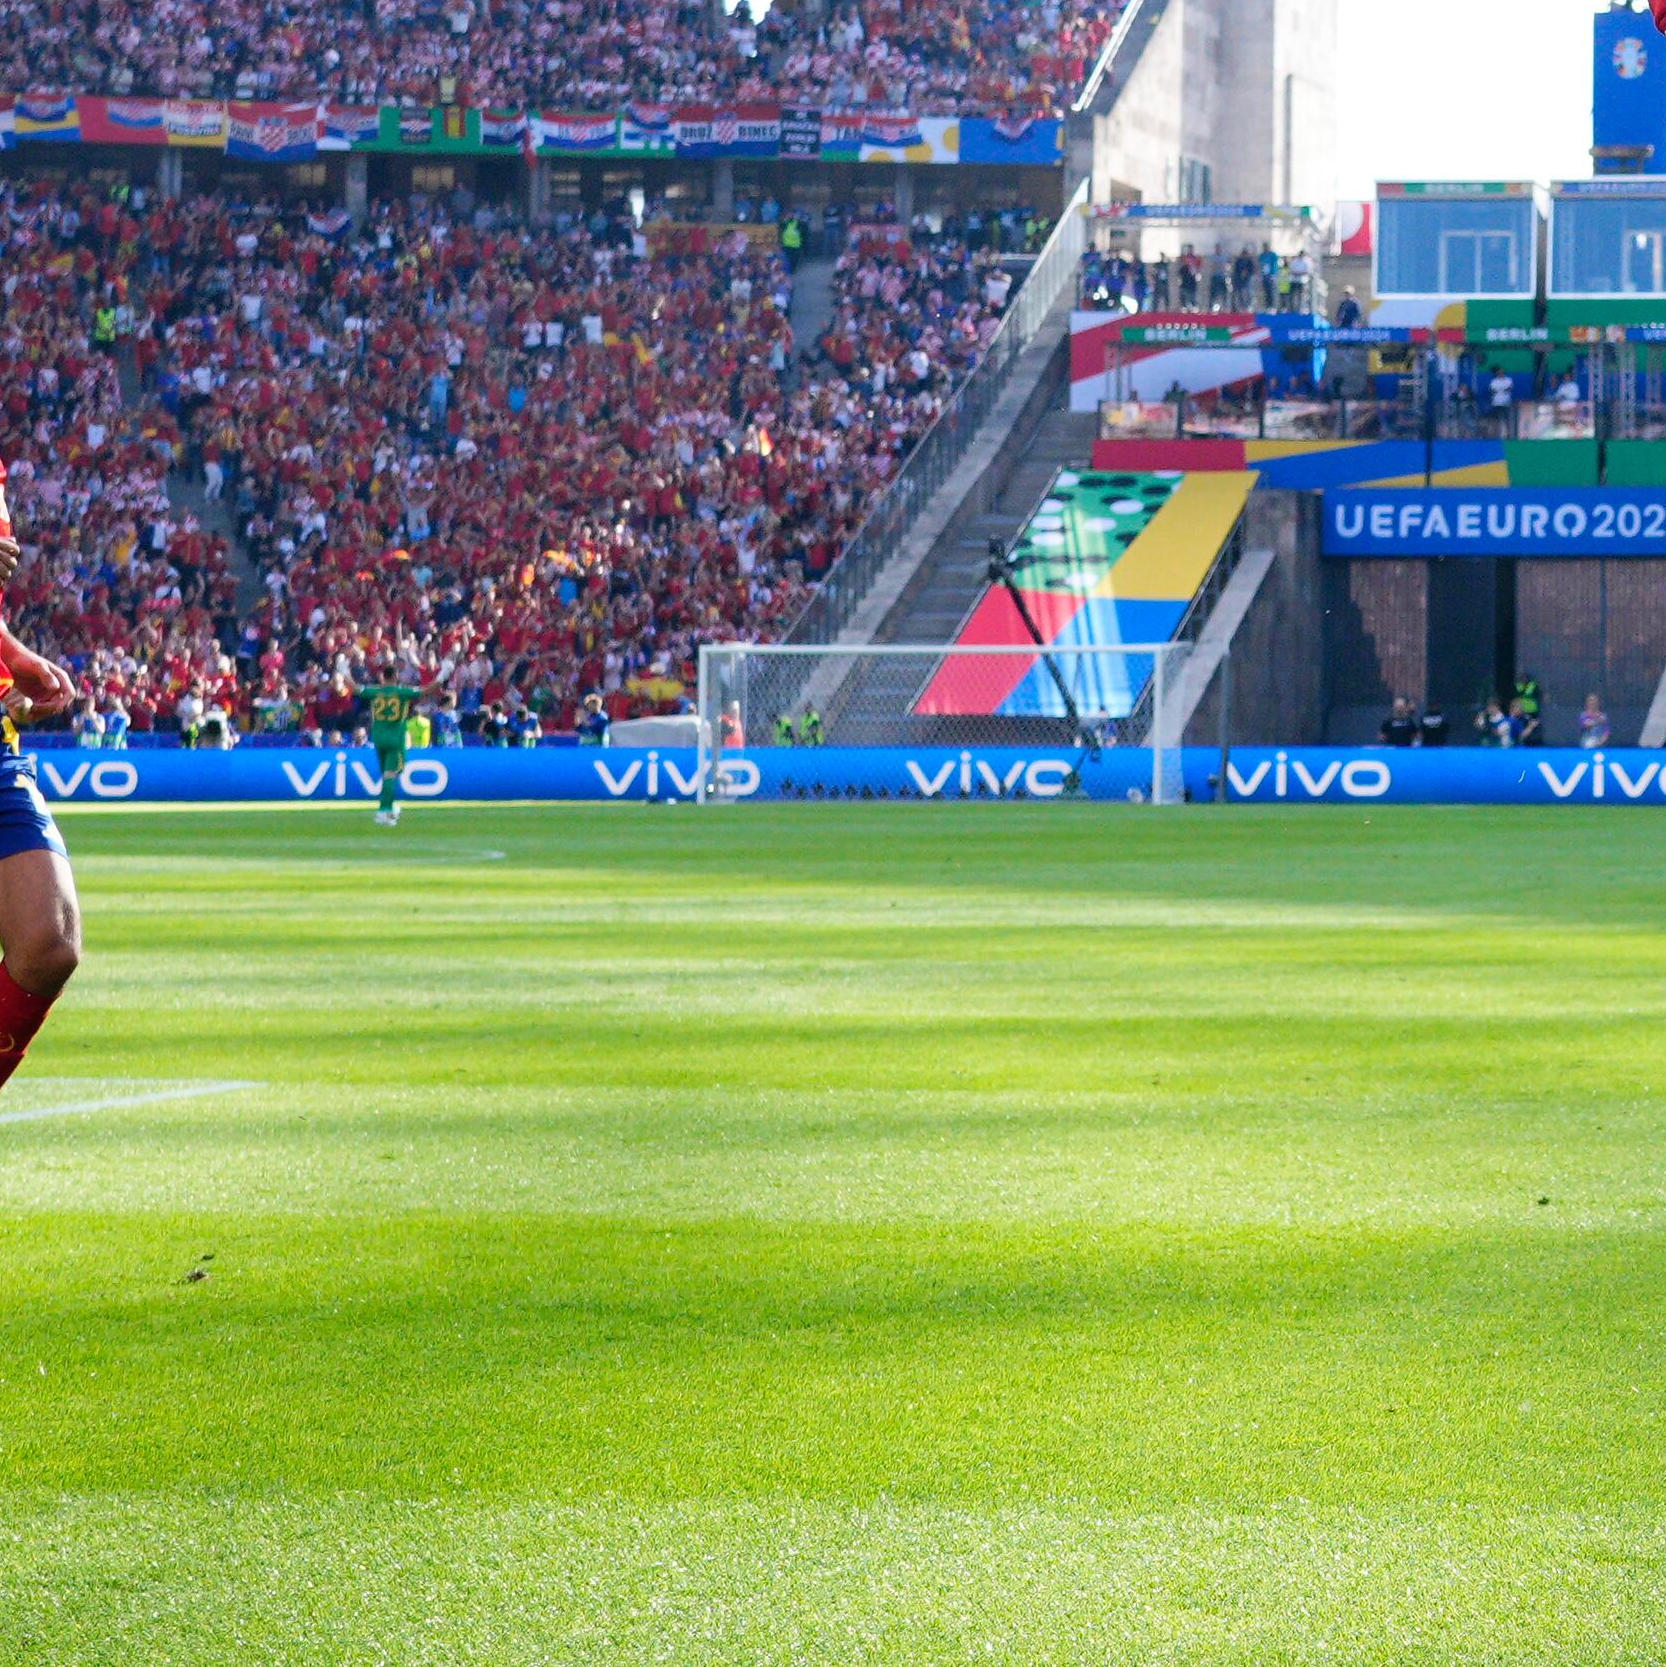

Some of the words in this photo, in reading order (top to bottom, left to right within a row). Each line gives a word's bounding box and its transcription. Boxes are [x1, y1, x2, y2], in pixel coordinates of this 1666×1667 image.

[373, 697, 400, 721] 23
[593, 751, 761, 797] vivo
[1228, 751, 1392, 797] vivo
